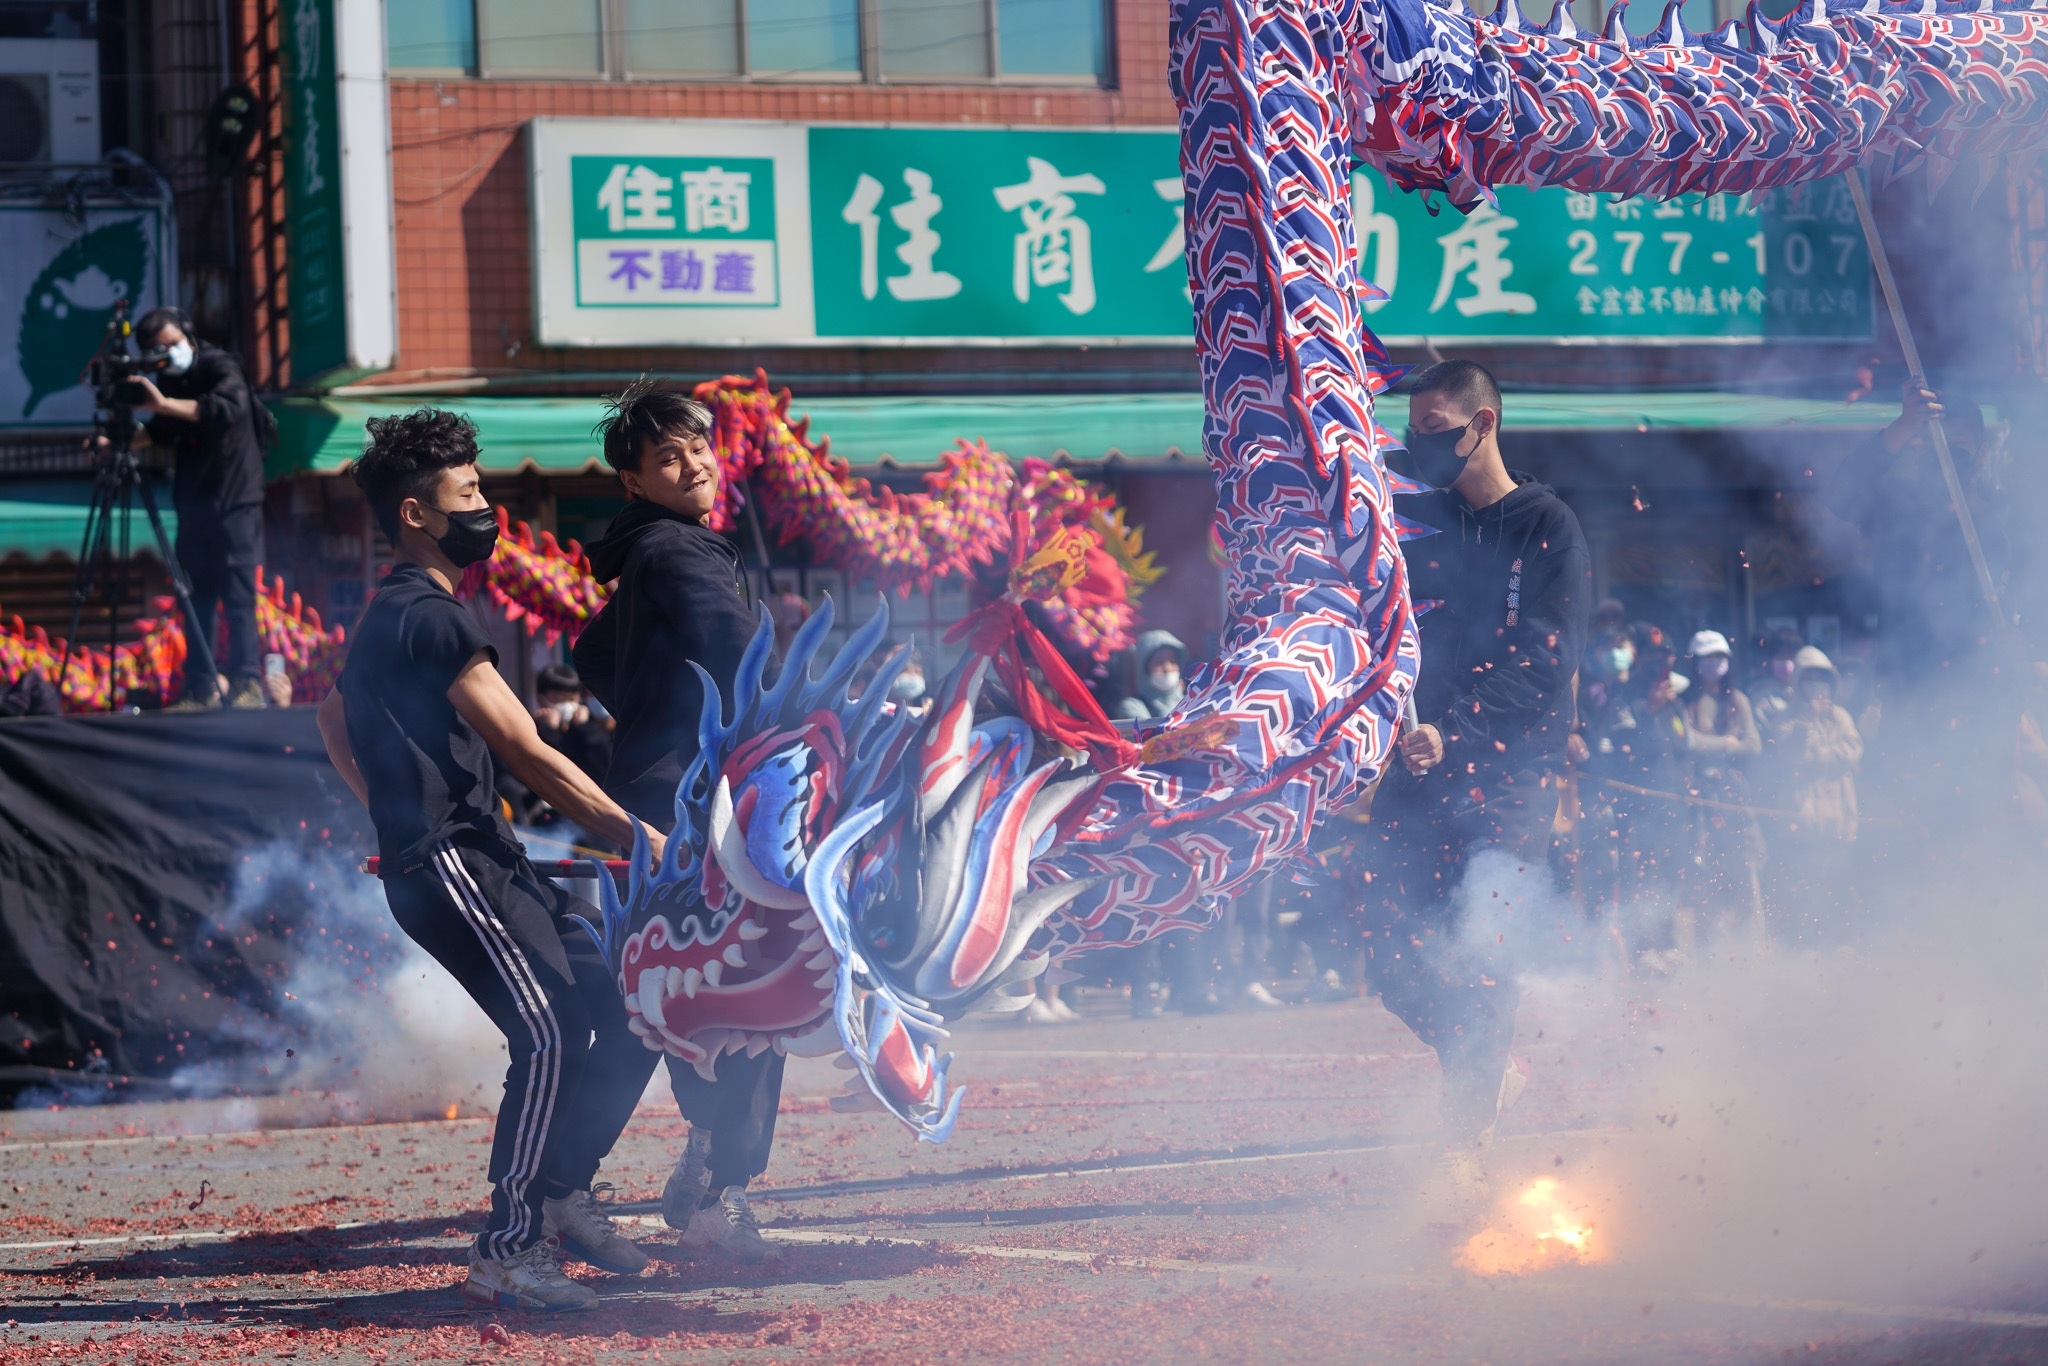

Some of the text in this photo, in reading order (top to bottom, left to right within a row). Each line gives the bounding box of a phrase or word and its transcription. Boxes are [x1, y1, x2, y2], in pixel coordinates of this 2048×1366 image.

[597, 163, 752, 233] 住商
[608, 249, 755, 292] 不動產
